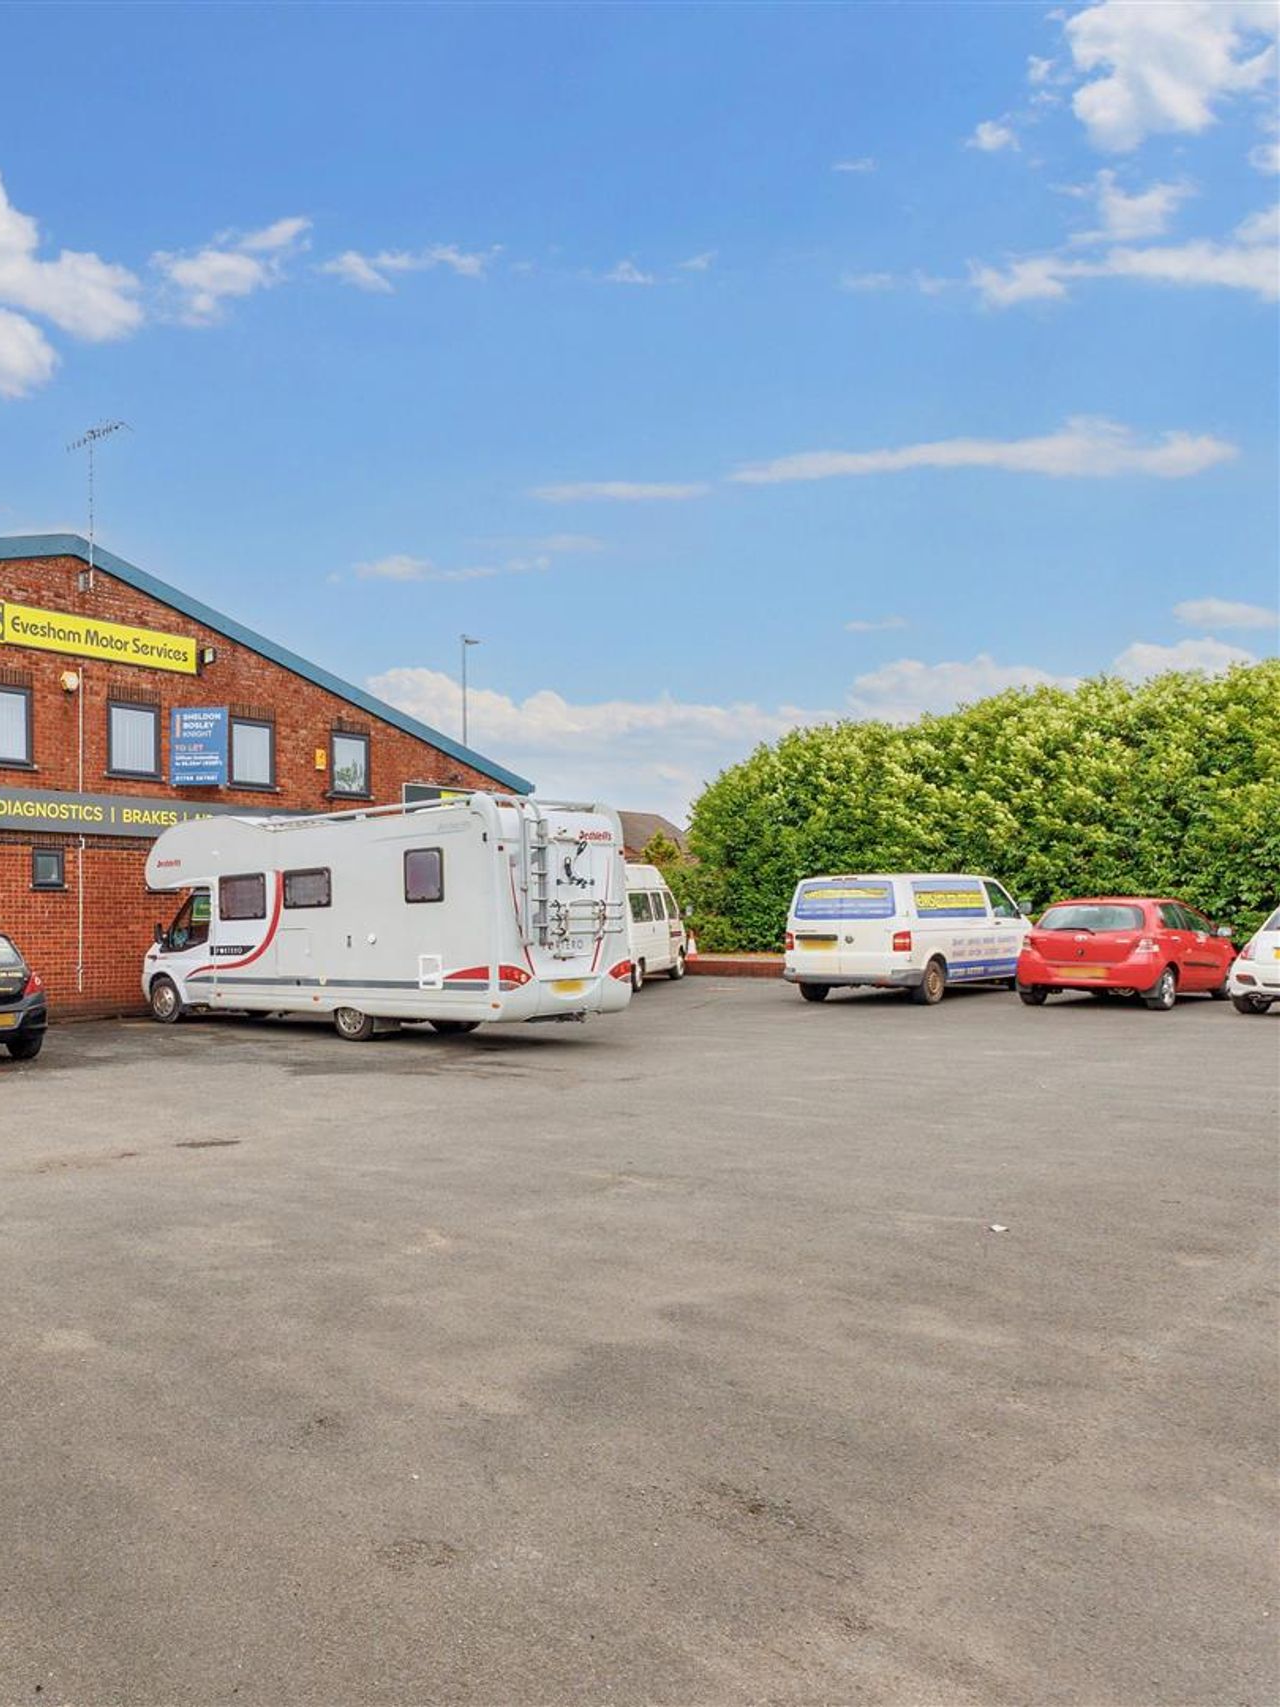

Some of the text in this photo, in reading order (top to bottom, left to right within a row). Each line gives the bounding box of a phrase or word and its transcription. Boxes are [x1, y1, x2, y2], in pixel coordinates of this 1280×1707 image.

[11, 615, 189, 663] Evesham Motor Services
[123, 808, 178, 825] BRAKES
